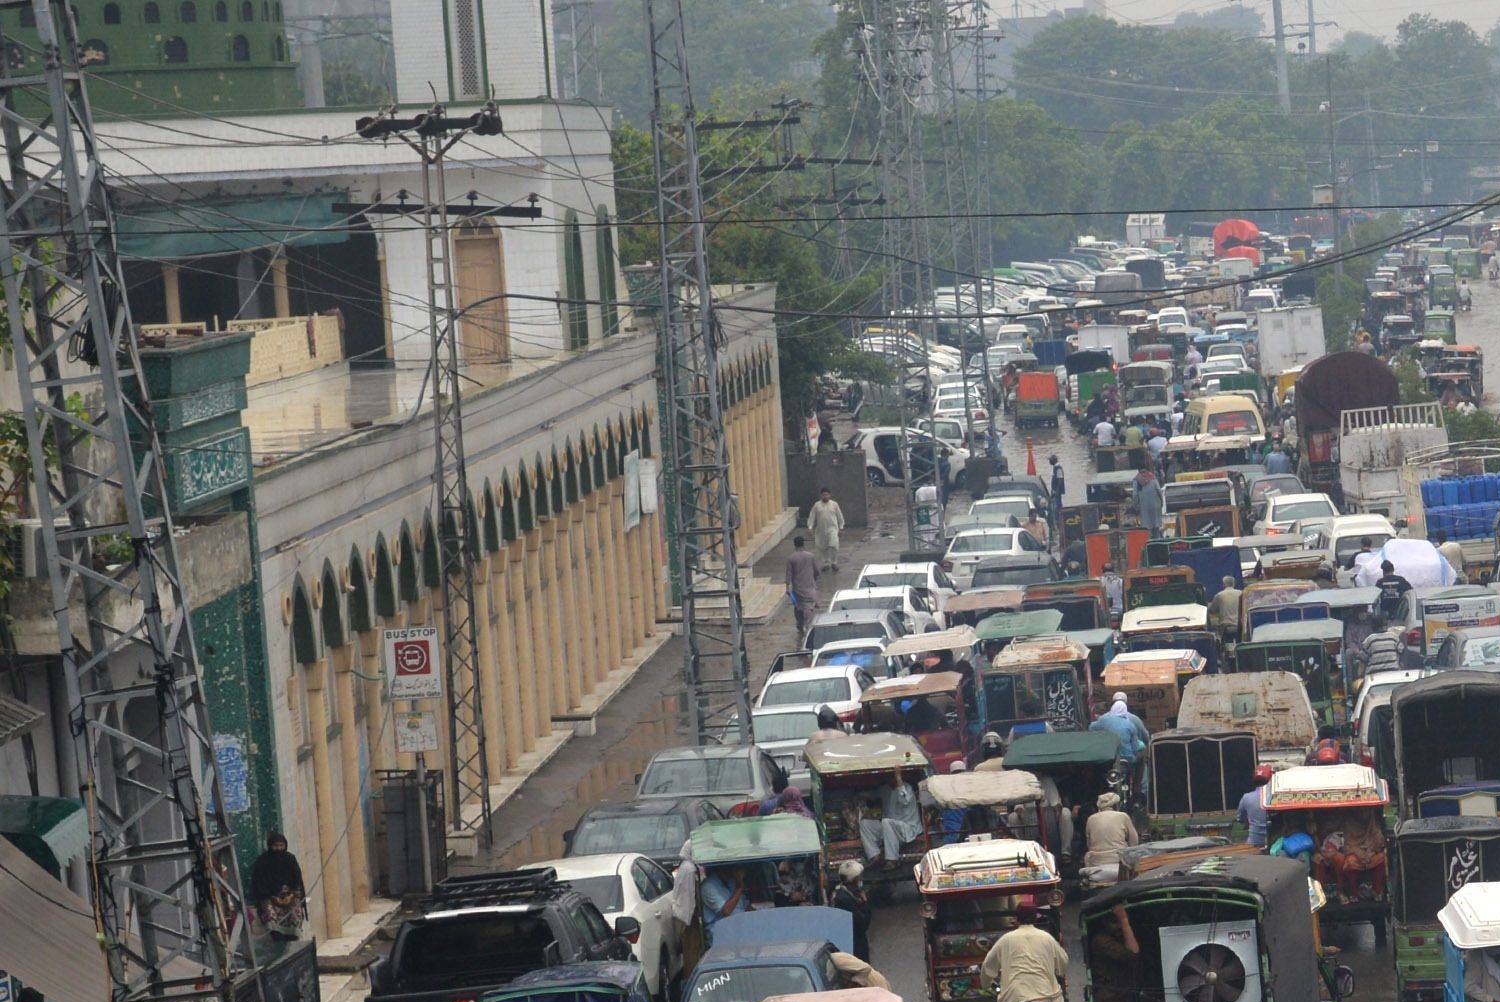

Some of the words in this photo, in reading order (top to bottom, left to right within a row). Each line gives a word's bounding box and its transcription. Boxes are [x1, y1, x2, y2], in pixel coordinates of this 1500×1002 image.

[385, 631, 407, 639] BUS
[409, 628, 436, 638] STOP
[697, 972, 731, 996] MIAN
